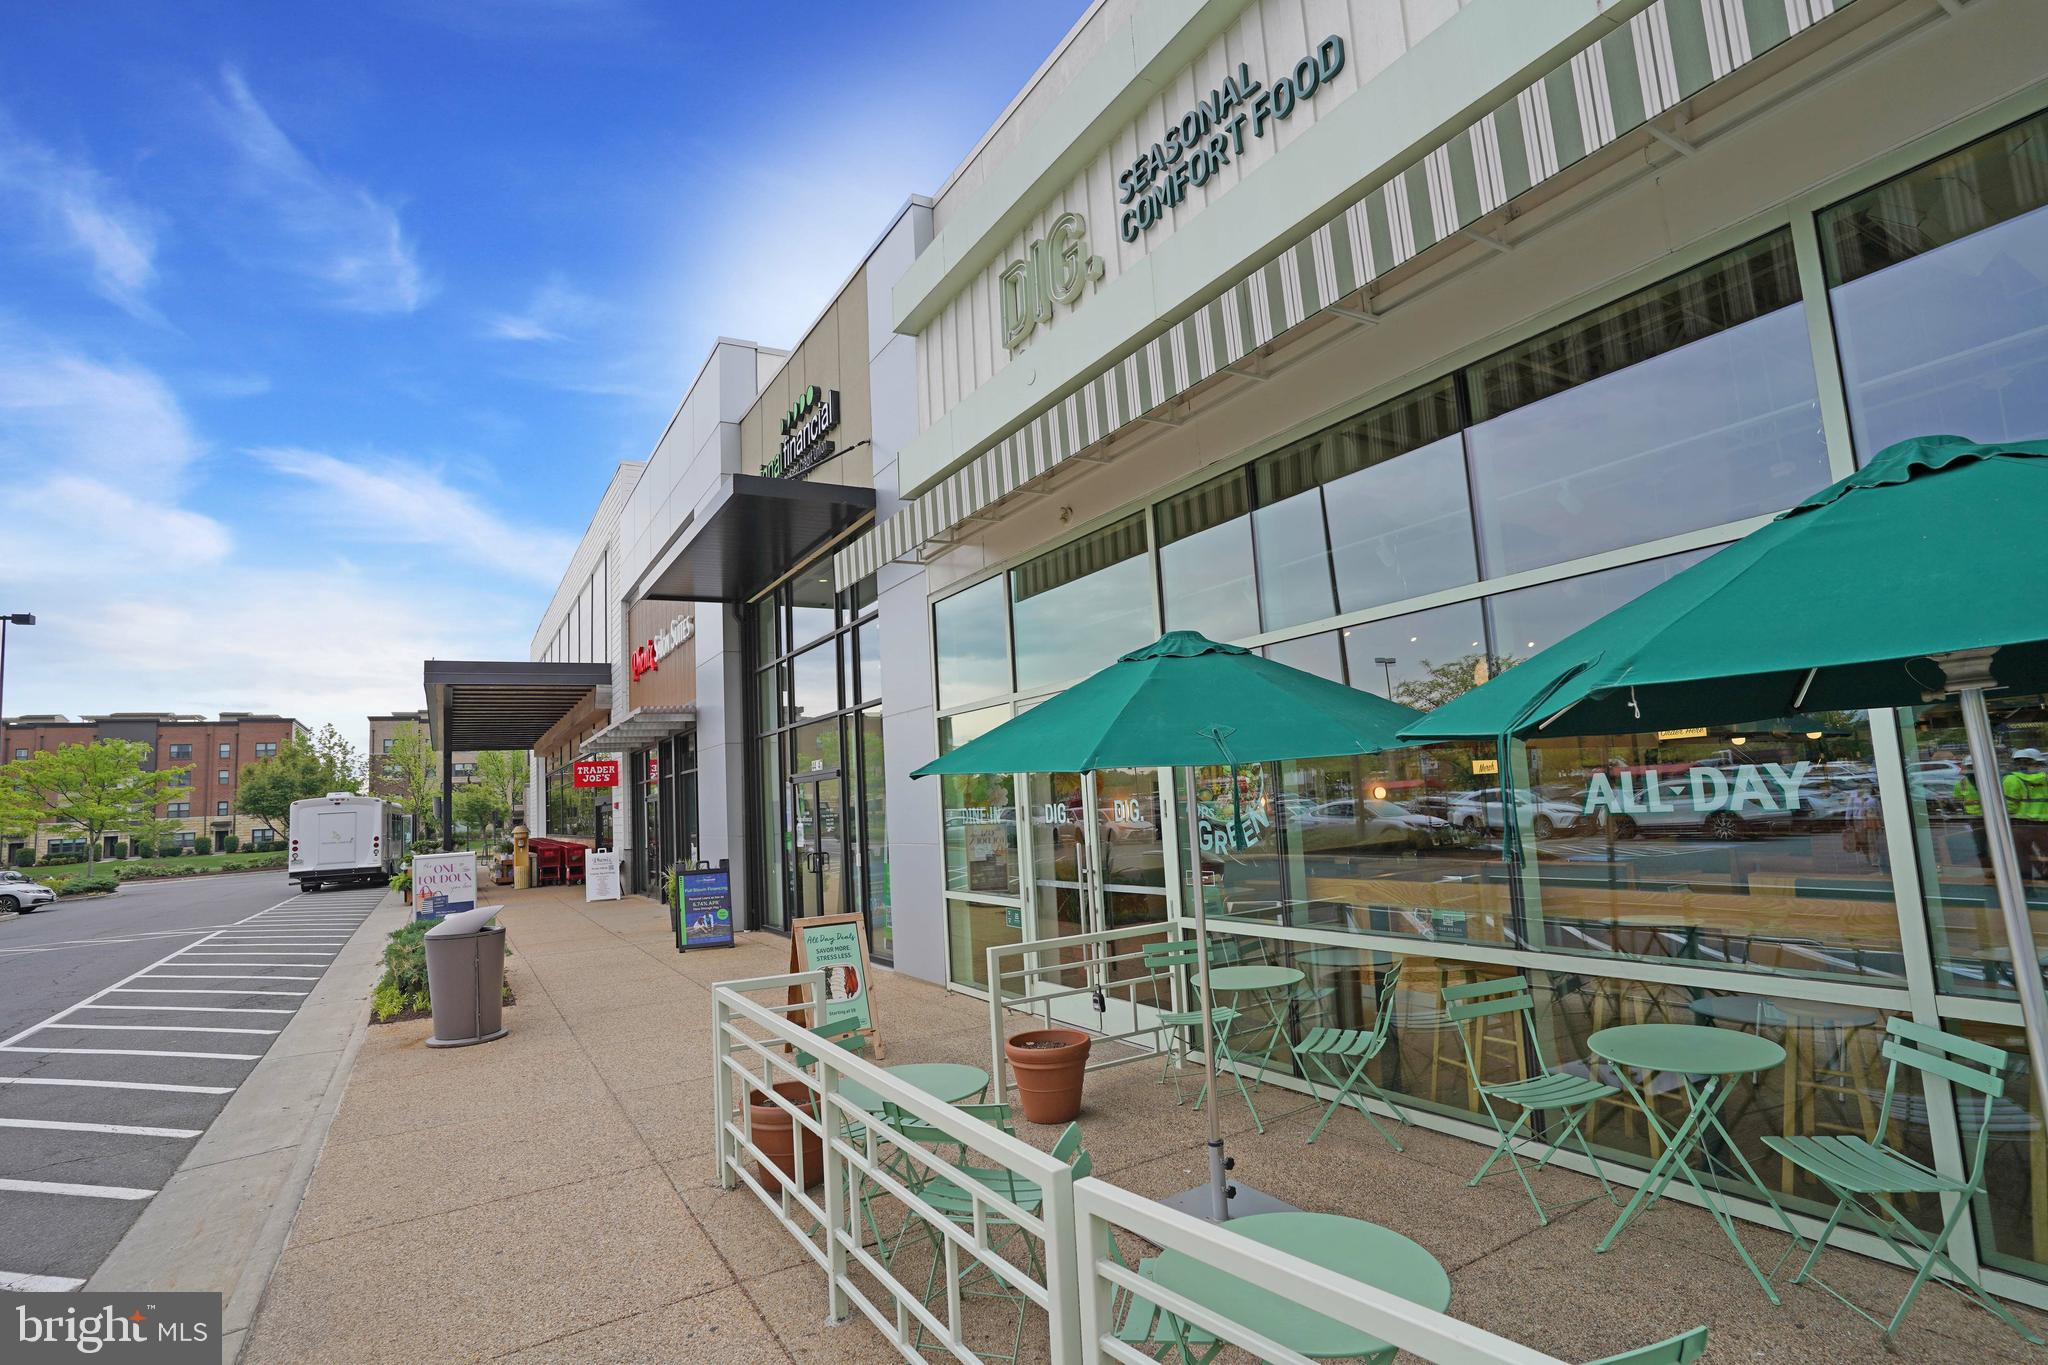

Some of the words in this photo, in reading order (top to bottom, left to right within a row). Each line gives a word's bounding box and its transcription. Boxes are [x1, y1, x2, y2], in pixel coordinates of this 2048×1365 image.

[1119, 62, 1261, 204] SEASONAL
[1120, 113, 1247, 243] COMFORT
[1252, 34, 1345, 138] FOOD
[783, 389, 839, 469] financial
[577, 766, 615, 775] TRADER
[582, 774, 610, 783] JOE'S
[1584, 771, 1675, 814] ALL
[1689, 761, 1811, 811] DAY
[1045, 803, 1072, 824] DIG.
[1113, 799, 1144, 823] DIG.
[807, 935, 820, 944] All
[820, 934, 835, 945] Day
[836, 932, 856, 941] Deals
[815, 946, 834, 955] SAVOR
[816, 953, 837, 962] STRESS
